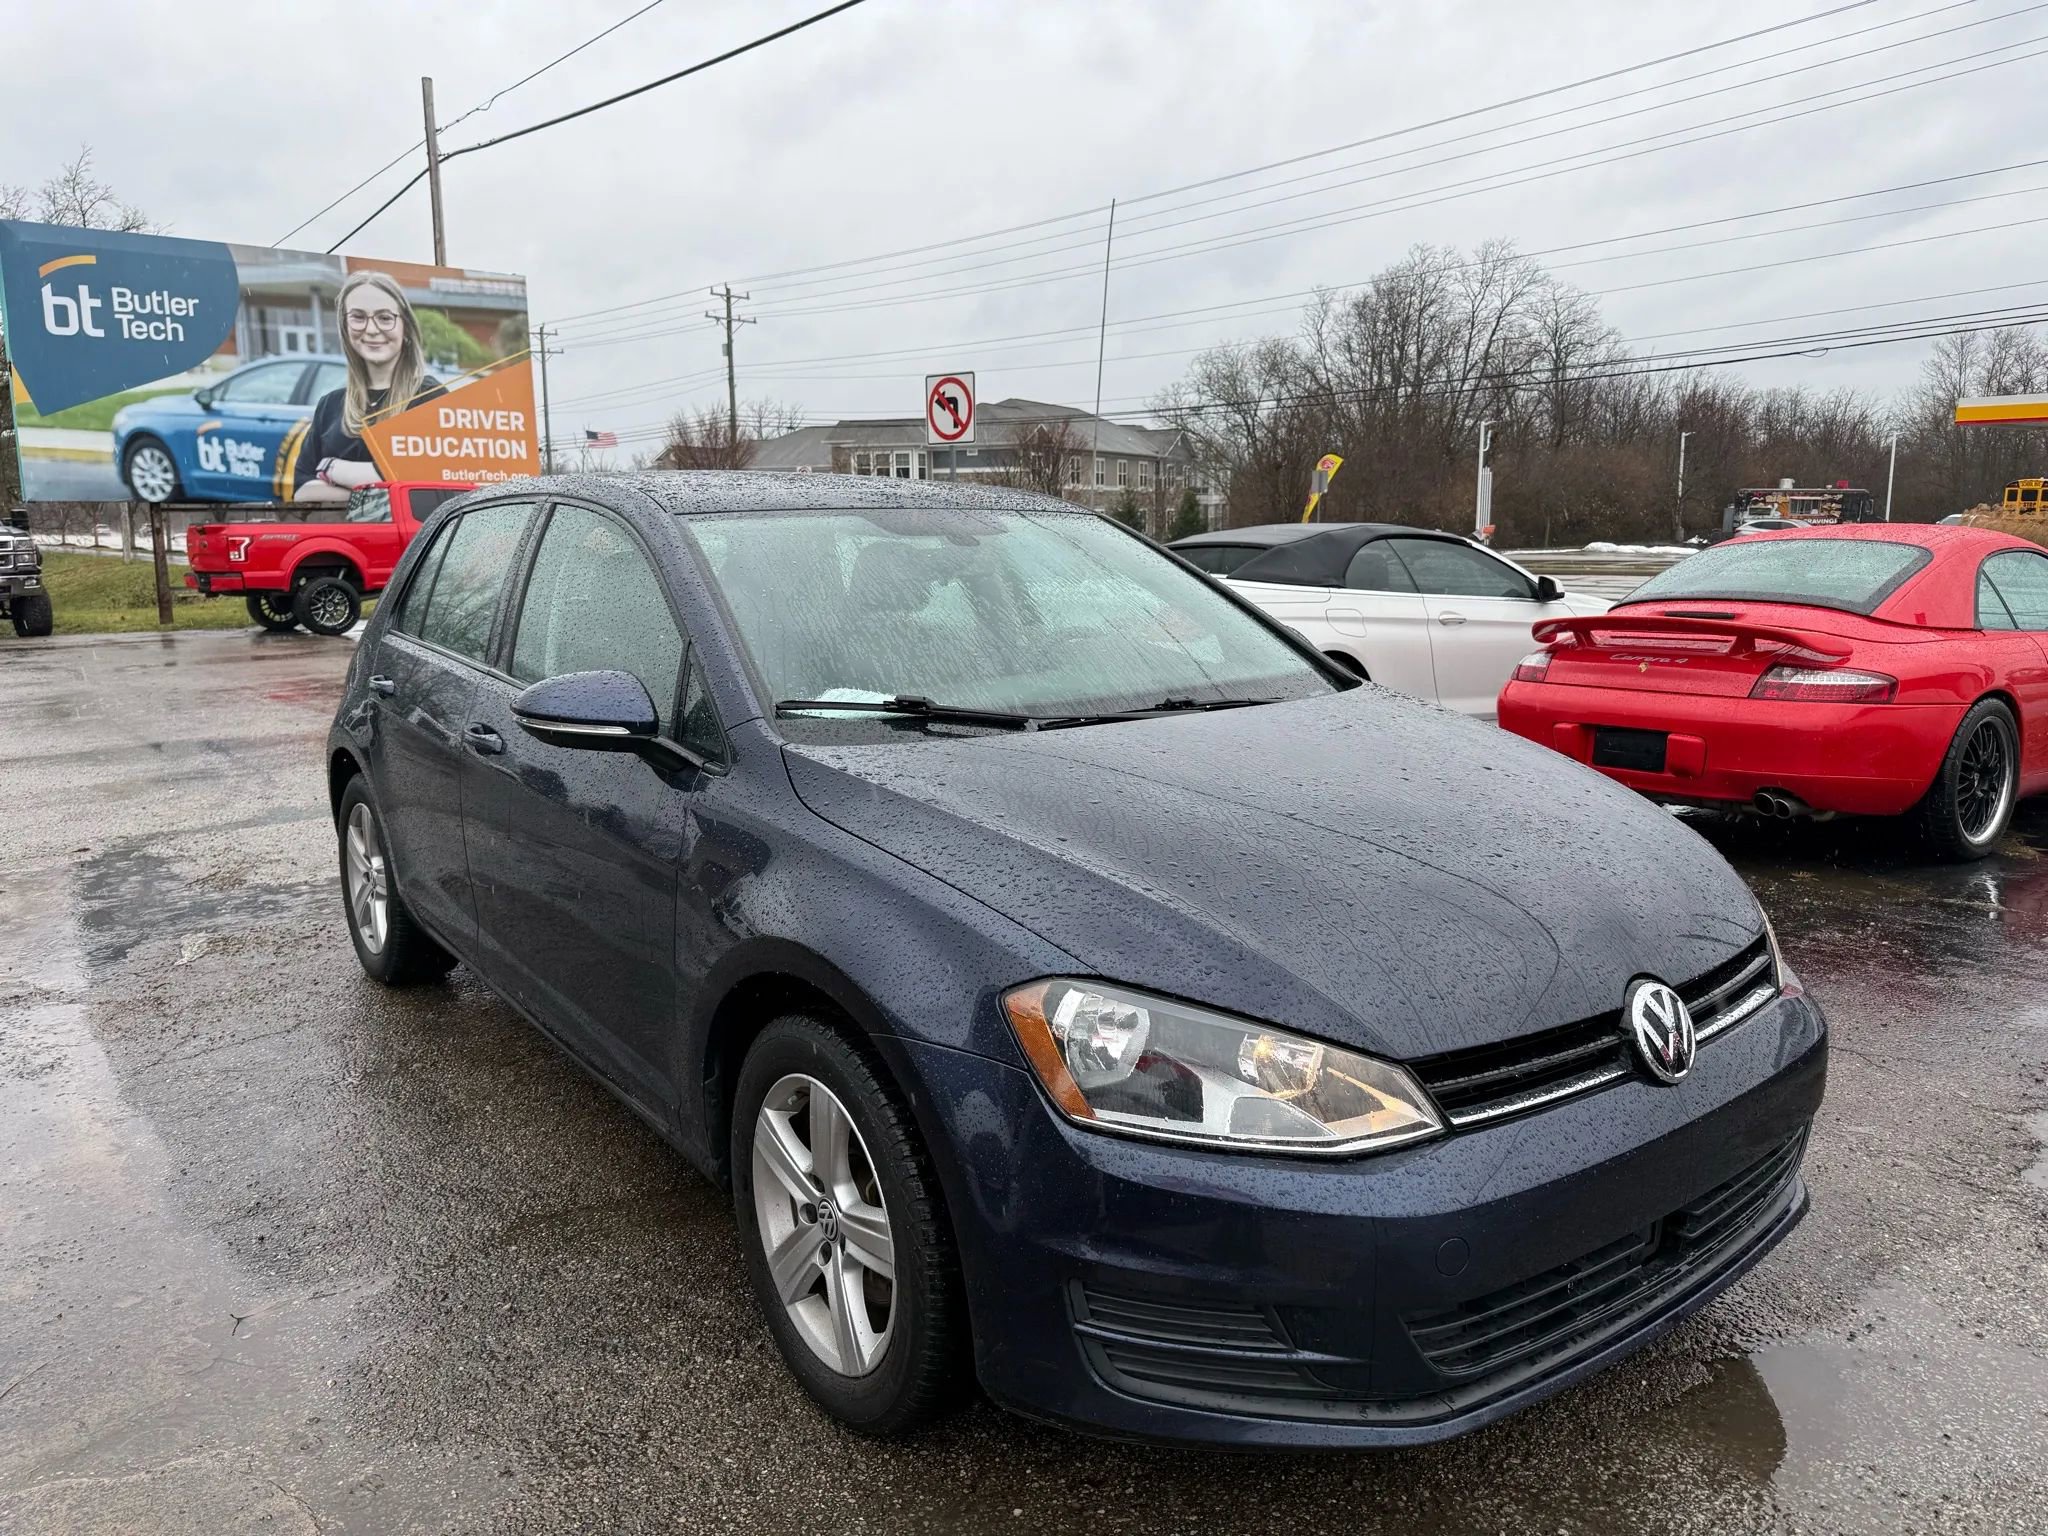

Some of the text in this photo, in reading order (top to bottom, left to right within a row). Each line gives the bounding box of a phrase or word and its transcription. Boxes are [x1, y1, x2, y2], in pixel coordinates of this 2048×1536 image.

[41, 282, 105, 338] bt
[111, 286, 199, 317] Butler
[114, 313, 184, 342] Tech
[438, 407, 525, 432] DRIVER
[391, 435, 528, 460] EDUCATION
